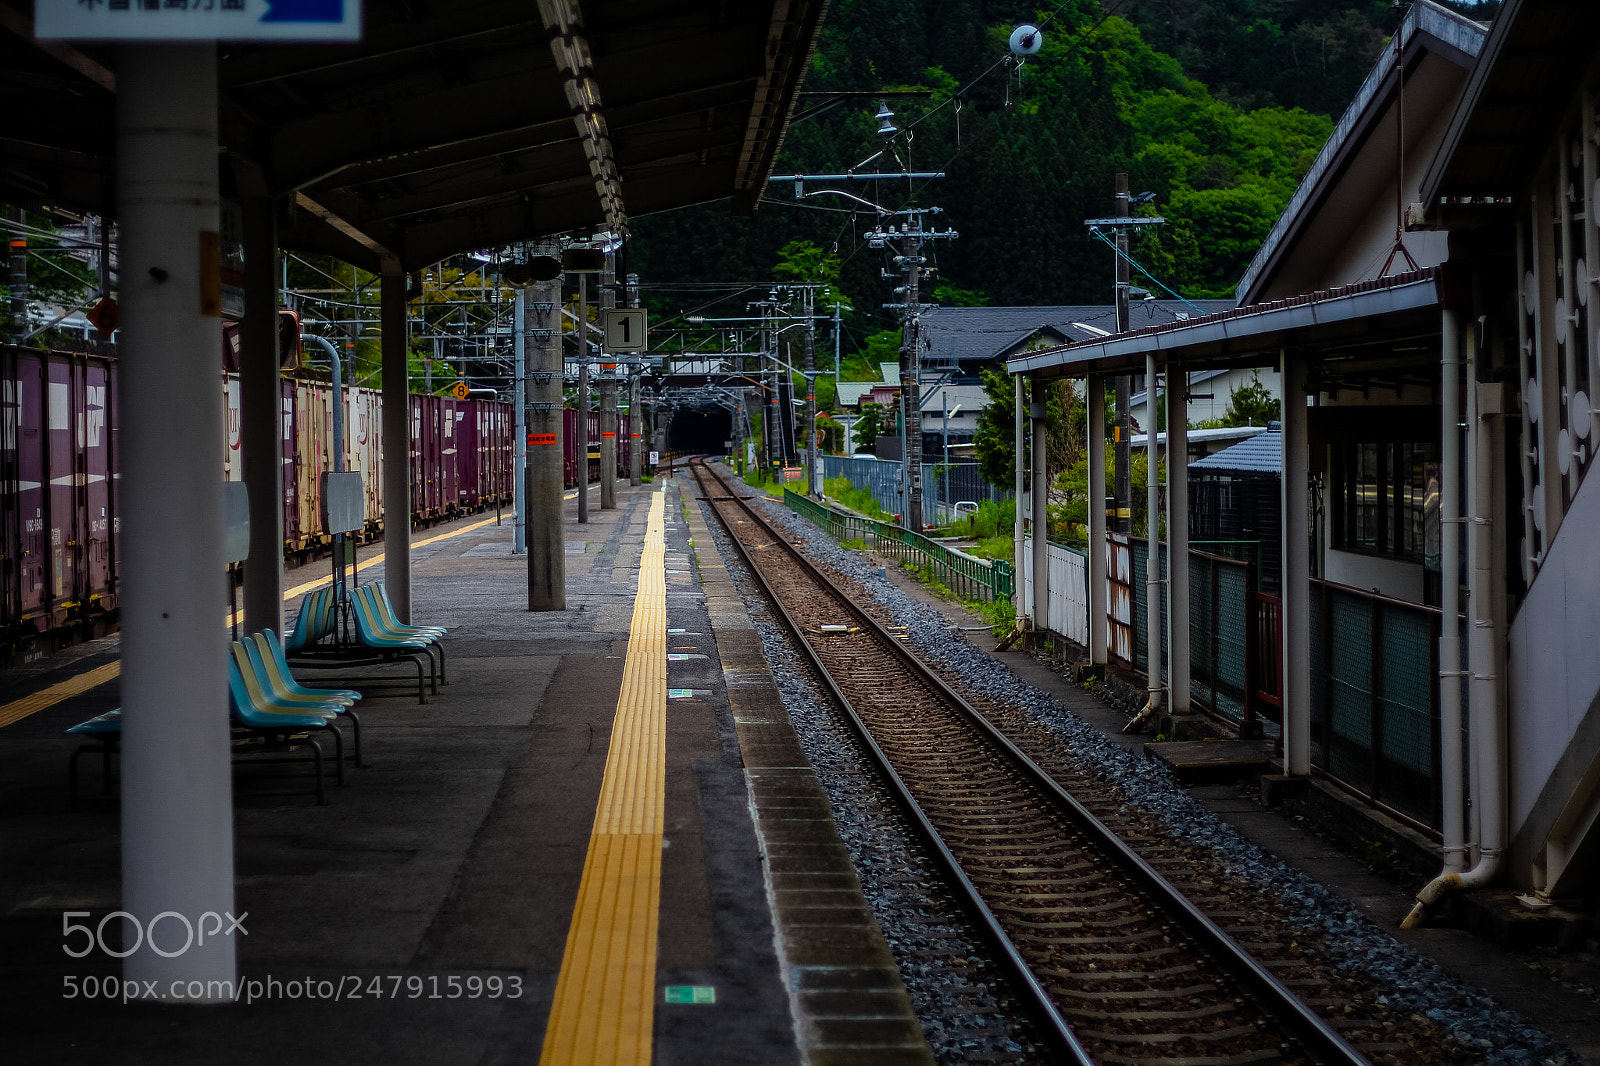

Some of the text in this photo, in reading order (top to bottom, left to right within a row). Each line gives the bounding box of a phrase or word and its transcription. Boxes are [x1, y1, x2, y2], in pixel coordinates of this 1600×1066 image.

[99, 306, 114, 328] 6
[617, 317, 630, 342] 1
[457, 385, 466, 397] 8
